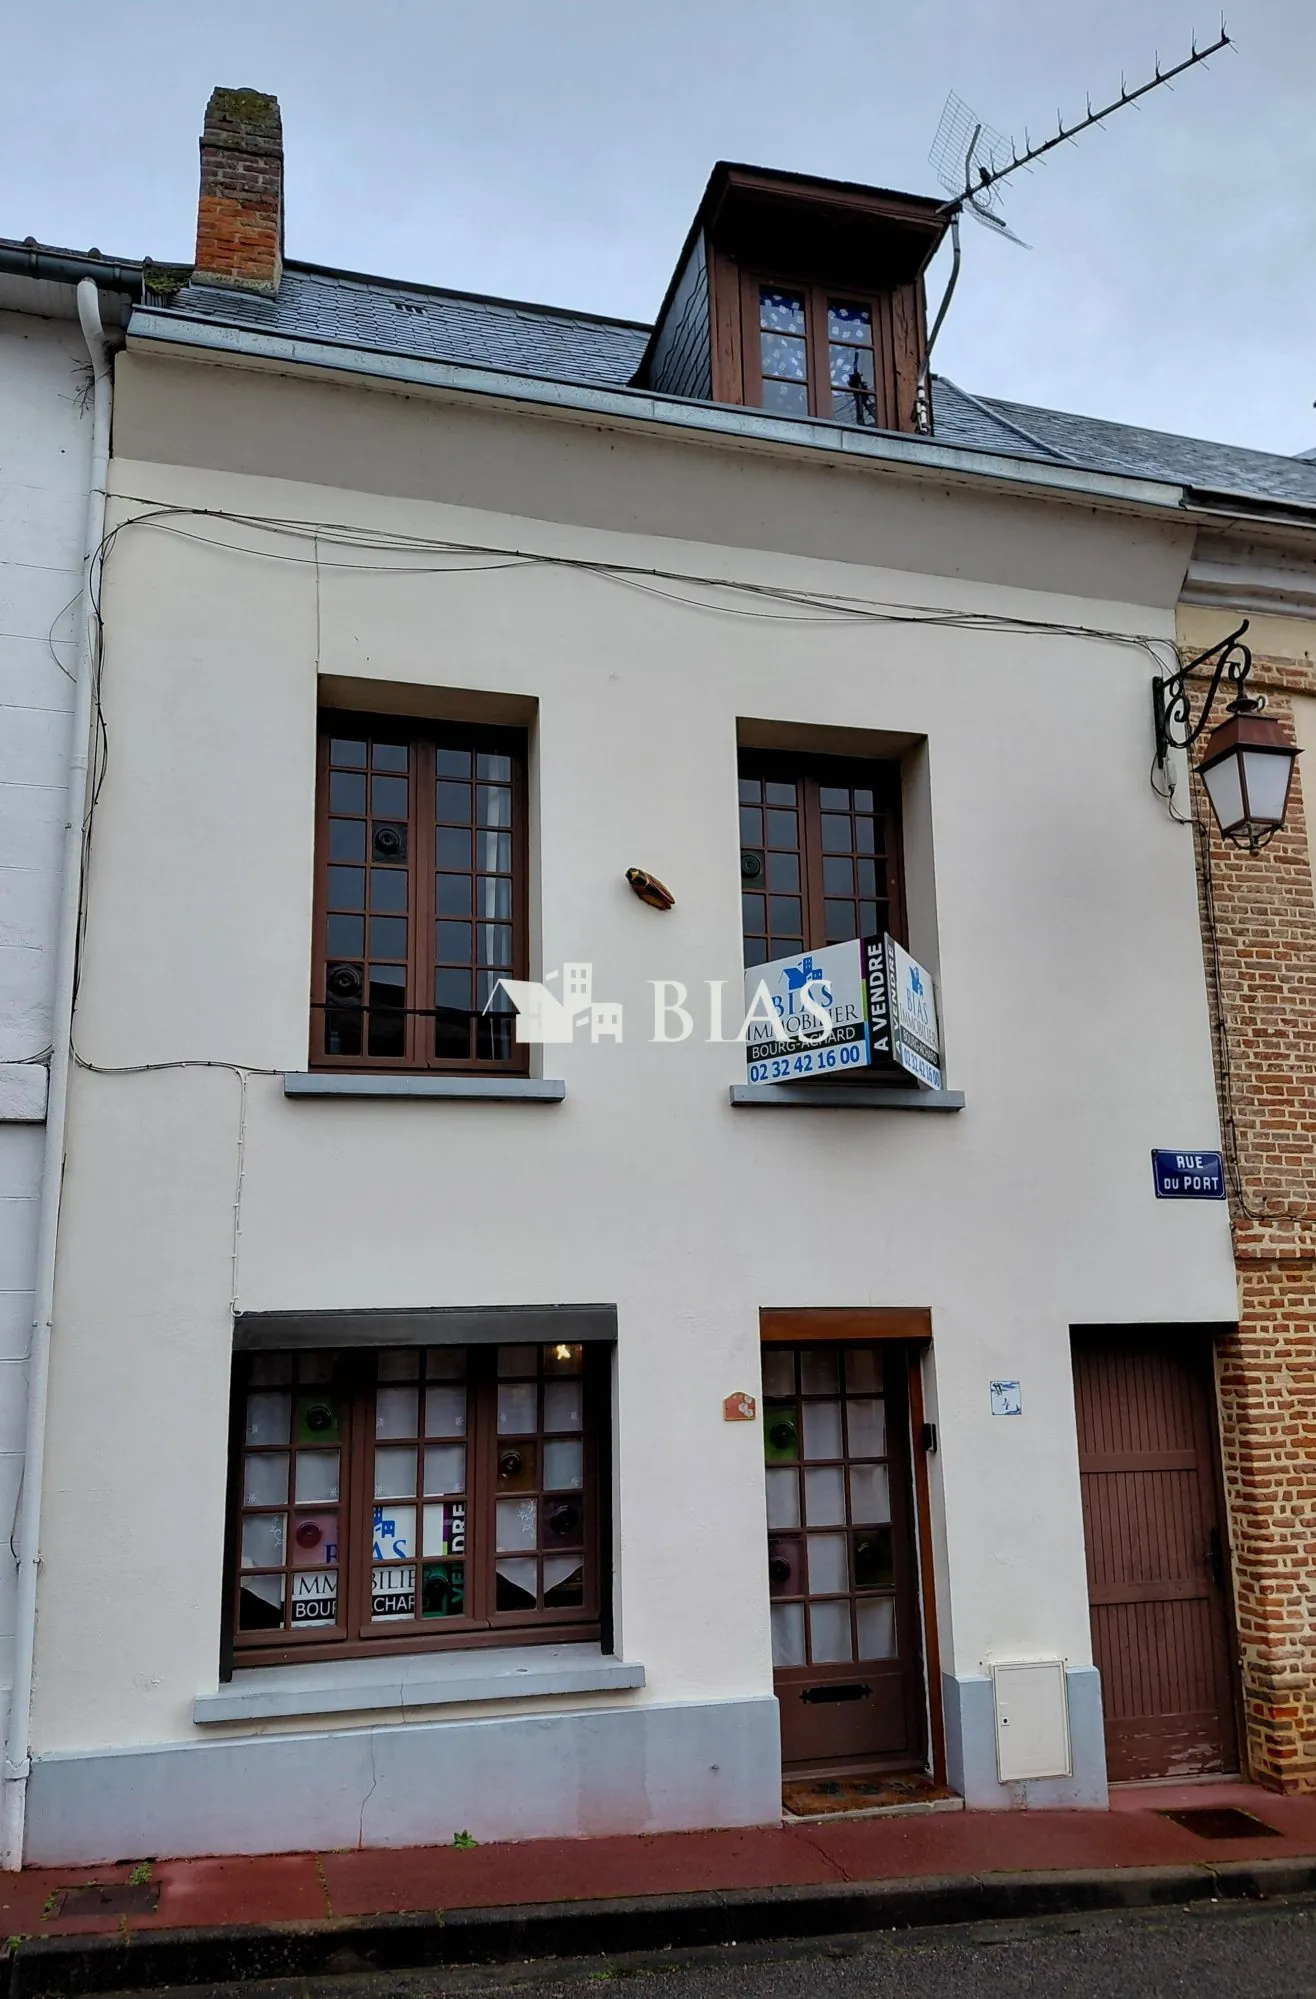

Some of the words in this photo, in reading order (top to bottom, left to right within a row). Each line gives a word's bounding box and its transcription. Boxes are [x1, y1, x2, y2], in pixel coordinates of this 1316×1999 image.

[867, 942, 887, 1032] VENDRE
[906, 986, 930, 1026] BIAS
[747, 1004, 860, 1042] IMOBIIER
[873, 1036, 889, 1051] A
[750, 1063, 768, 1083] 02
[772, 1059, 790, 1078] 32
[794, 1054, 813, 1073] 42
[817, 1049, 836, 1069] 16
[840, 1045, 860, 1064] 00
[1176, 1156, 1203, 1169] RUE
[1164, 1177, 1179, 1190] DU
[1183, 1176, 1219, 1190] PORT
